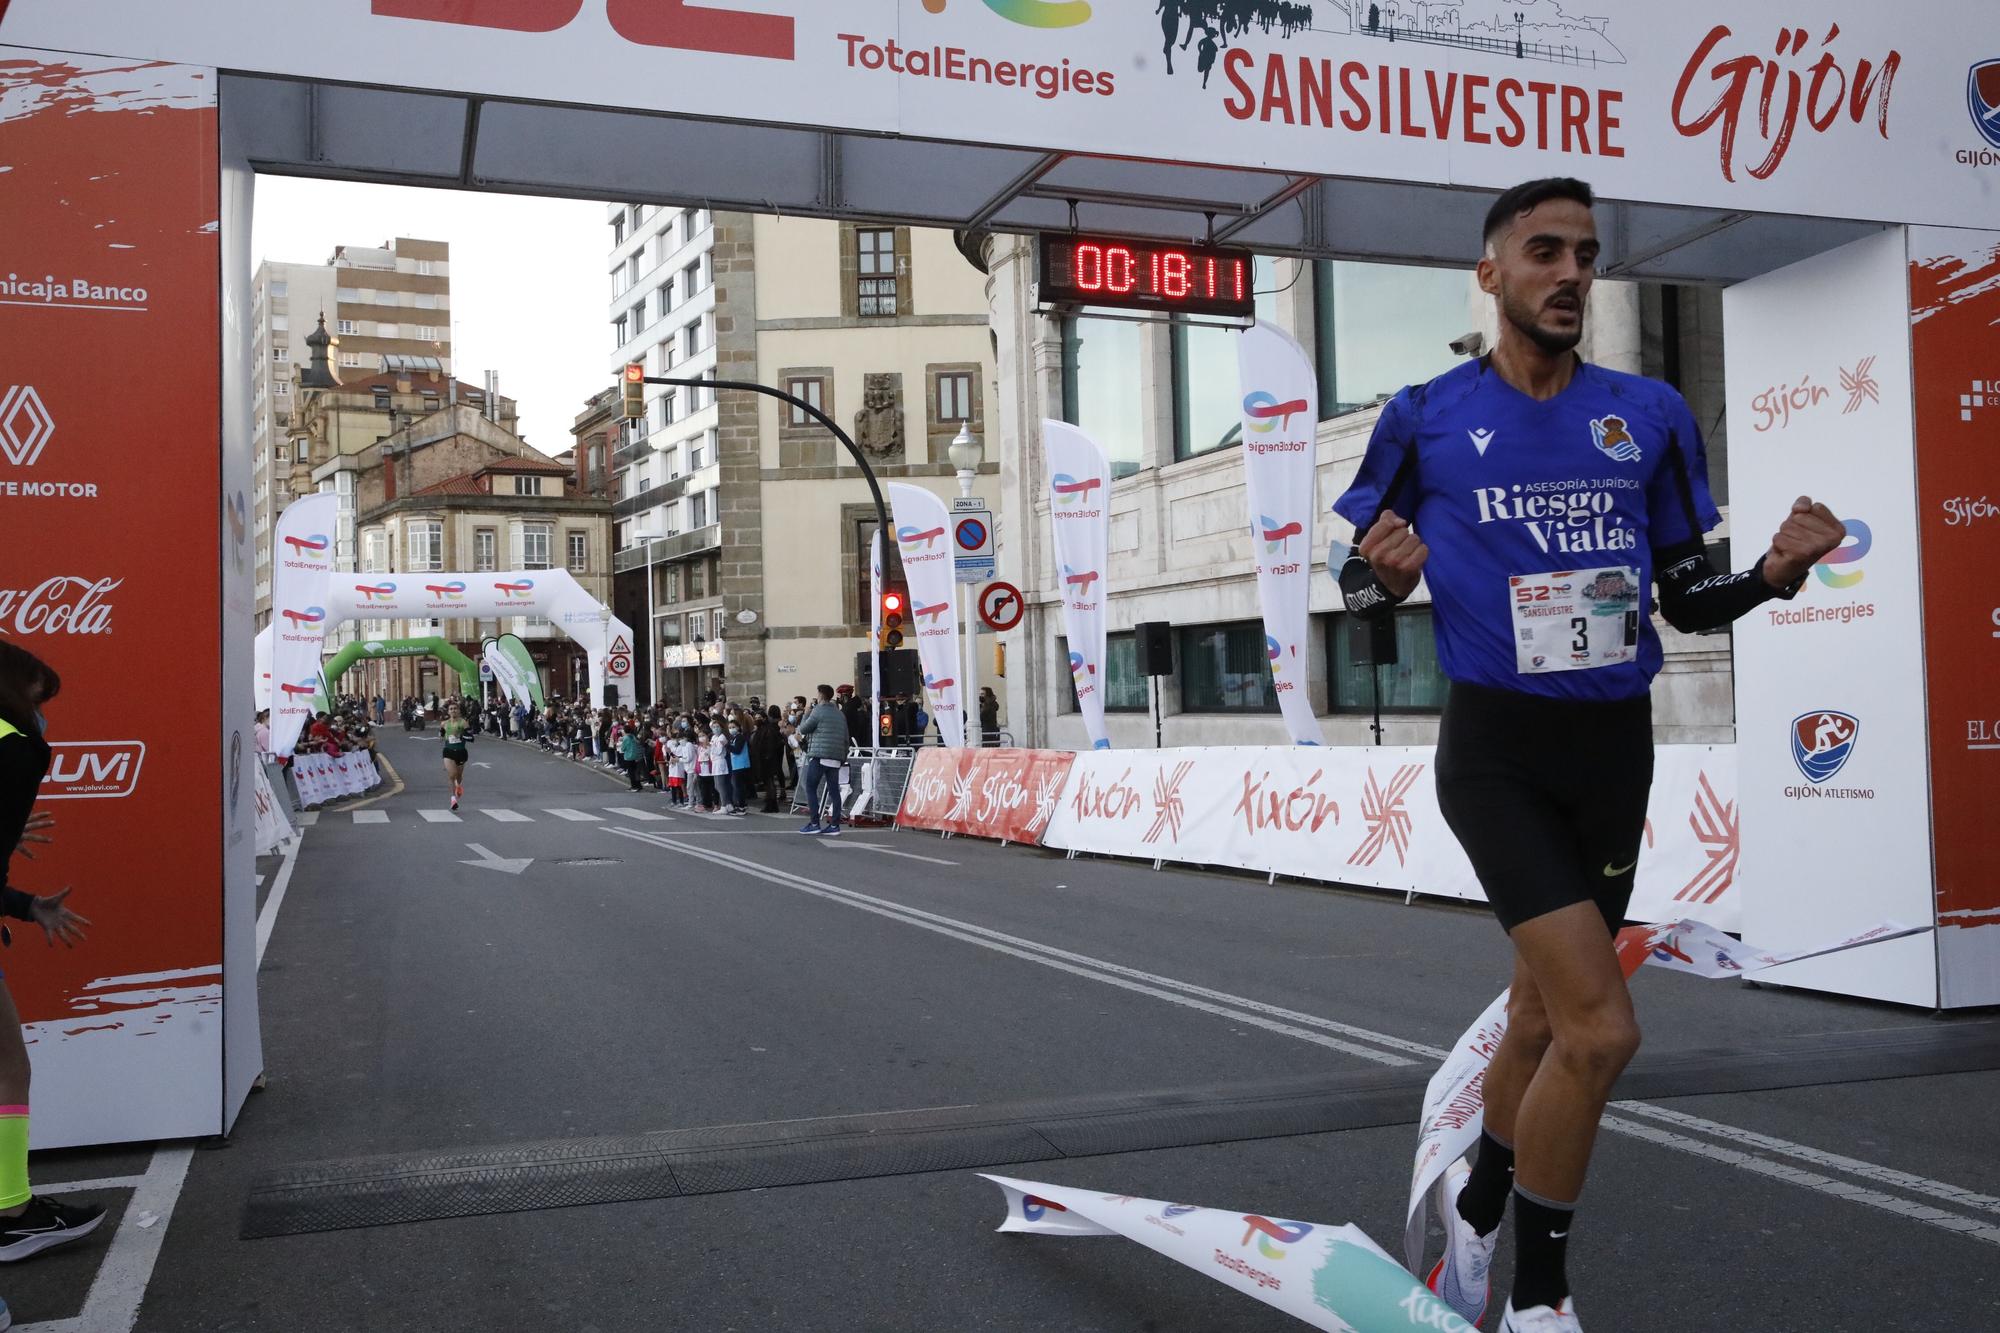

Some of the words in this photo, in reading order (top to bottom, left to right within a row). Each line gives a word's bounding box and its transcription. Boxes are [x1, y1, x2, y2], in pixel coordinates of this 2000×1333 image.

[837, 33, 1115, 100] TotalEnergies
[1223, 47, 1625, 158] SANSILVESTRE
[1671, 22, 1901, 183] Gijón
[1077, 245, 1245, 300] 00:18:11
[72, 279, 149, 302] Banco
[22, 482, 98, 497] MOTOR
[1525, 479, 1589, 493] ASESORÍA
[1590, 477, 1640, 490] JURÍDICA
[1473, 484, 1614, 527] Riesgo
[1523, 517, 1637, 554] Vialás
[1516, 585, 1550, 603] 52
[1523, 605, 1574, 618] SANSILVESTRE
[1768, 600, 1875, 627] TotalEnergies
[1570, 616, 1589, 652] 3
[614, 661, 626, 669] 30
[1967, 720, 1991, 741] EL
[1784, 783, 1822, 800] GIJÓN
[1824, 788, 1875, 799] ATLETISMO
[1214, 1248, 1282, 1291] TotalEnergies
